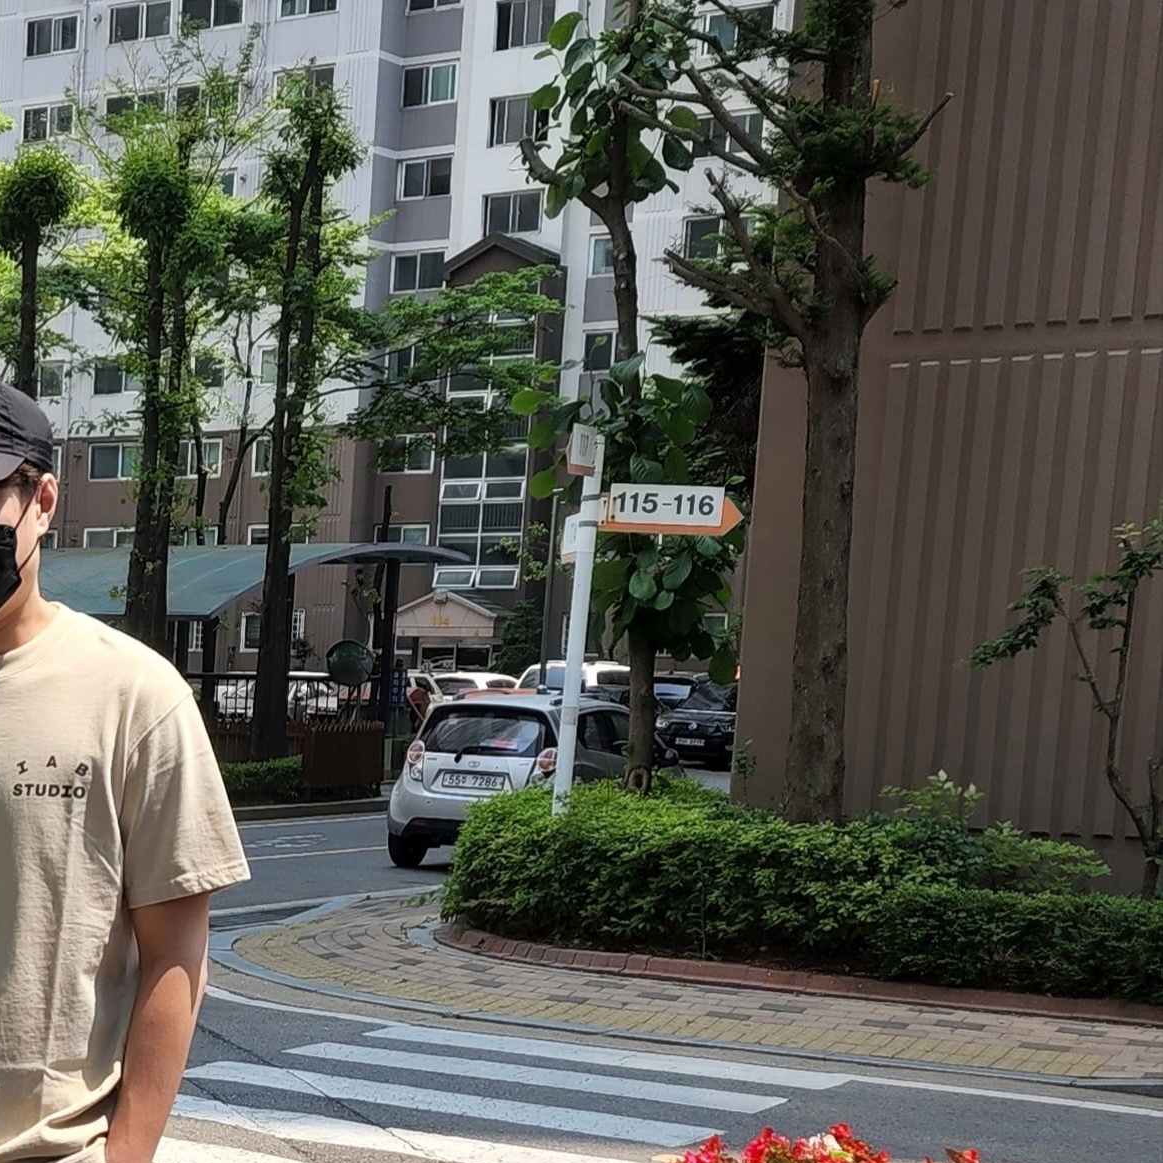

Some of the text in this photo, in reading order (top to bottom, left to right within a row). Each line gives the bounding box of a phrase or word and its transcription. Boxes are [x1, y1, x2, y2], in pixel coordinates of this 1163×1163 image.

[617, 491, 715, 516] 115-116
[472, 776, 498, 787] 7286
[12, 783, 87, 799] STUDIO
